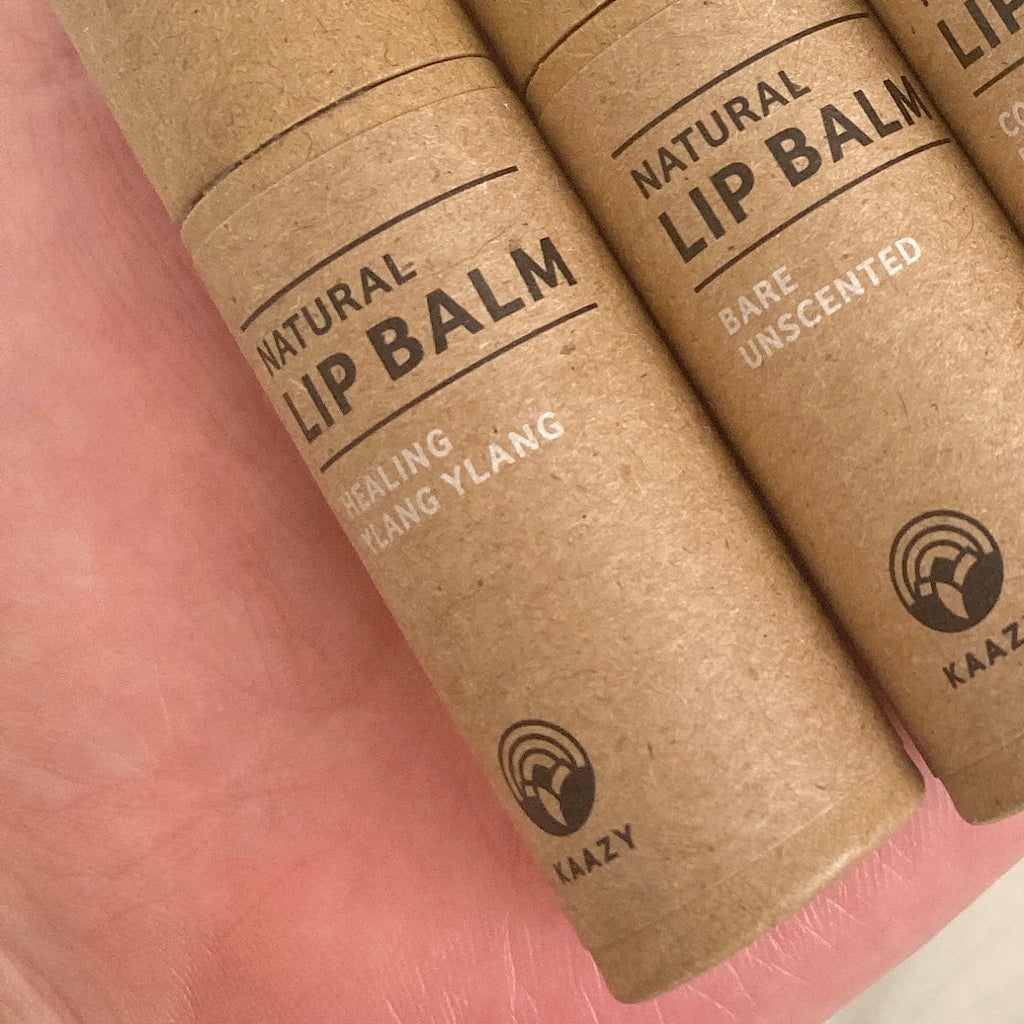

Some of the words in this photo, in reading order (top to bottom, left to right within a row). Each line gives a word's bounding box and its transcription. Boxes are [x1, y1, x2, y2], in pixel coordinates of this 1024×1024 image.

[630, 70, 811, 199] NATURAL
[658, 162, 755, 264] LIP
[764, 76, 933, 187] BALM
[256, 253, 418, 376] NATURAL
[283, 351, 357, 444] LIP
[365, 237, 577, 382] BALM
[718, 265, 798, 336] BARE
[738, 236, 923, 369] UNSCENTED
[340, 428, 453, 518] HEALING
[361, 486, 441, 556] YLANG
[440, 411, 566, 496] YLANG
[553, 823, 635, 884] KAAZY
